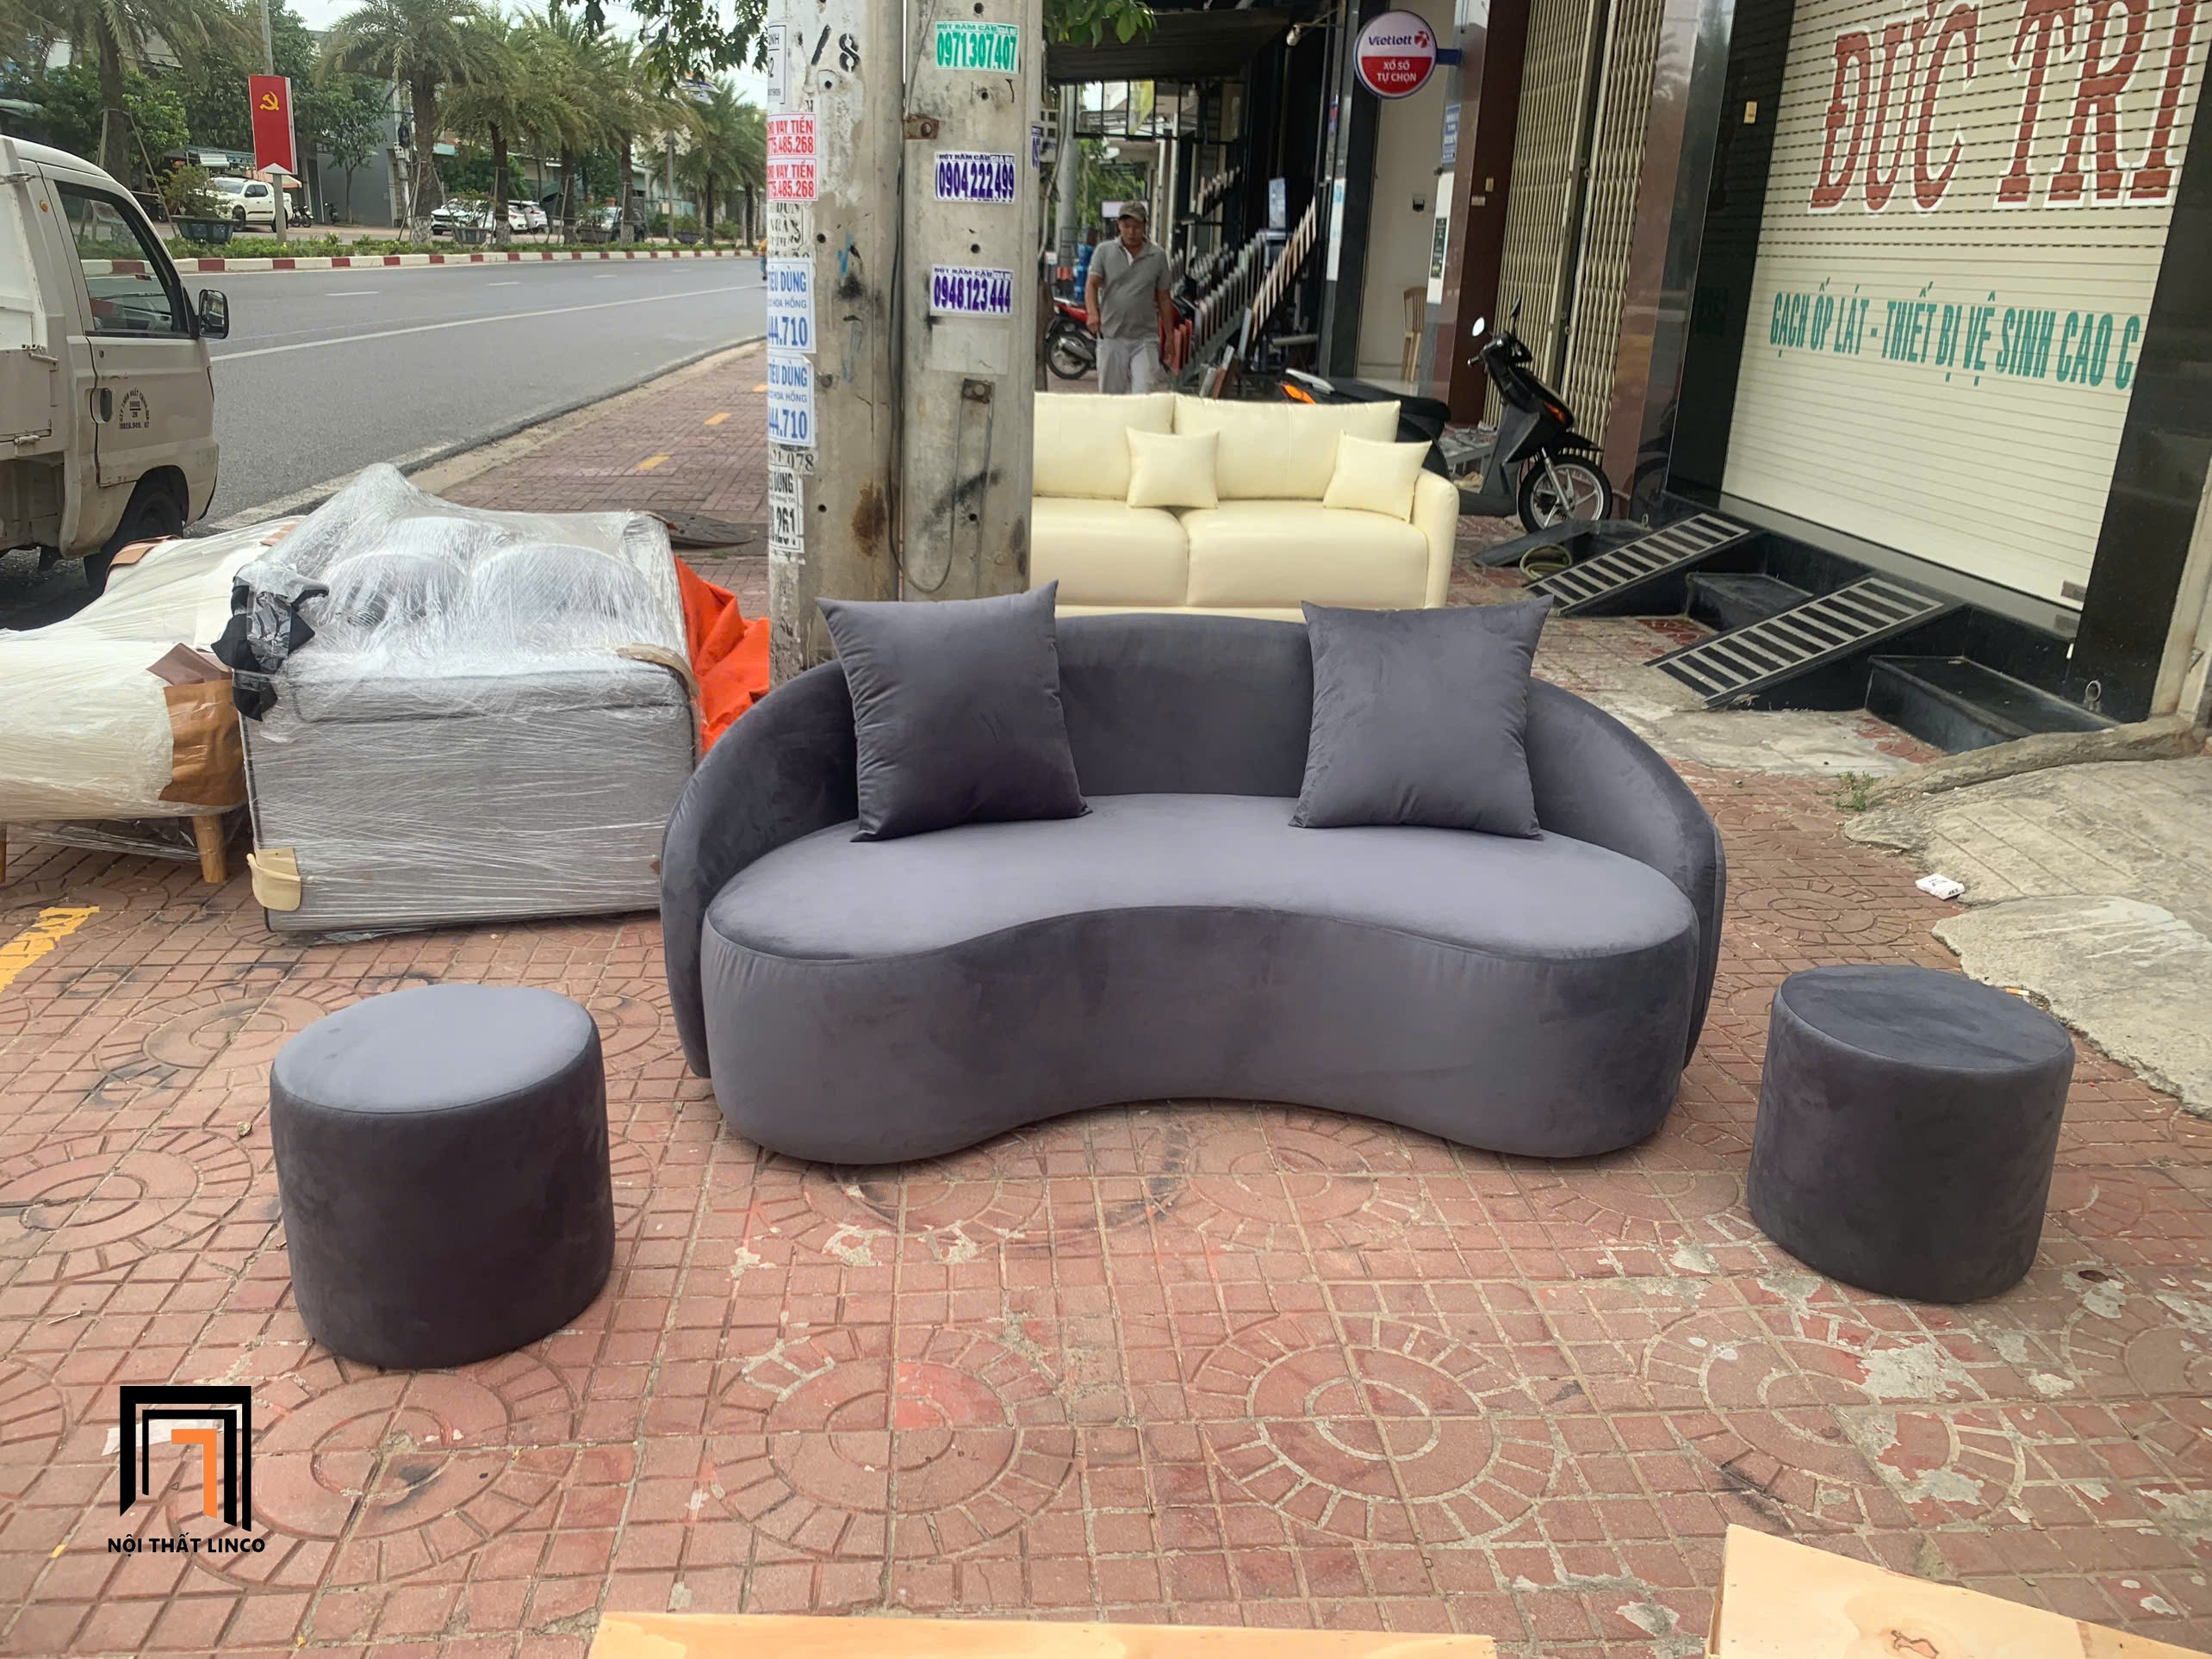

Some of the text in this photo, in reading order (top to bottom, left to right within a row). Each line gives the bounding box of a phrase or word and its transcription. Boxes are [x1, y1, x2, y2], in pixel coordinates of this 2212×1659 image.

[937, 32, 1016, 71] 0971.307.407
[1369, 35, 1413, 45] Vietlott
[1390, 72, 1417, 84] CHỌN
[780, 264, 807, 293] DÙNG
[935, 276, 1010, 313] 0948.123.444
[1770, 291, 1810, 357] GẠCH
[1810, 276, 1834, 351] ỐP
[1833, 284, 1870, 356] LÁT
[1881, 281, 1938, 363] THIẾT
[1936, 304, 1962, 382] BỊ
[1963, 289, 1996, 386] VỆ
[1996, 307, 2056, 379] SINH
[2056, 311, 2114, 387] CAO
[782, 360, 808, 388] DÙNG
